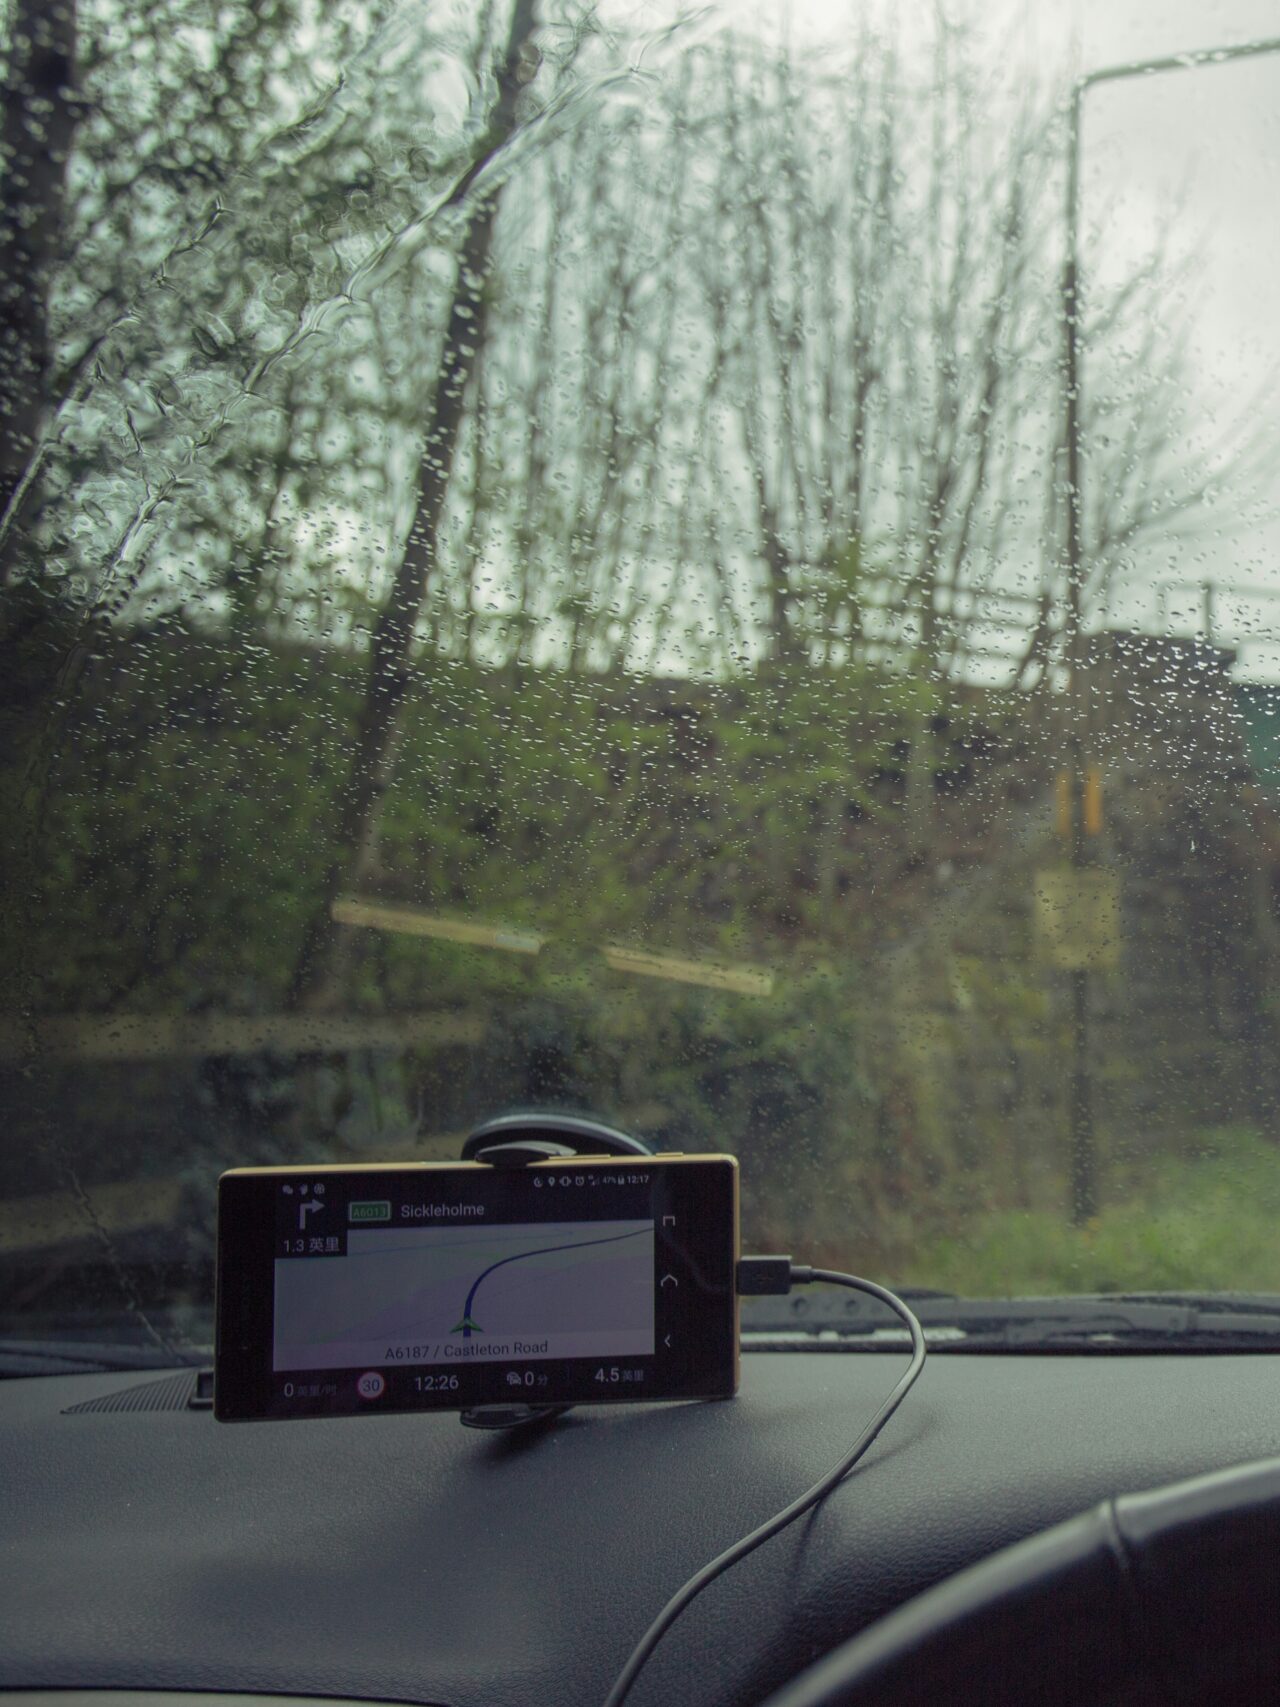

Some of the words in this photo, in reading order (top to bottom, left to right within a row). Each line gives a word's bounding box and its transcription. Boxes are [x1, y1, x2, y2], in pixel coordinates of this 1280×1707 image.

[627, 1174, 649, 1185] 12:17
[401, 1202, 485, 1218] Sickleholme
[283, 1239, 304, 1253] 1.3
[309, 1236, 340, 1253] 英里
[384, 1345, 430, 1360] A6187
[433, 1345, 440, 1359] /
[444, 1343, 509, 1358] Castleton
[514, 1340, 549, 1355] Road
[415, 1374, 459, 1391] 12:26
[524, 1370, 534, 1386] 0
[594, 1367, 620, 1383] 4.5
[284, 1382, 294, 1398] 0
[362, 1379, 380, 1393] 30
